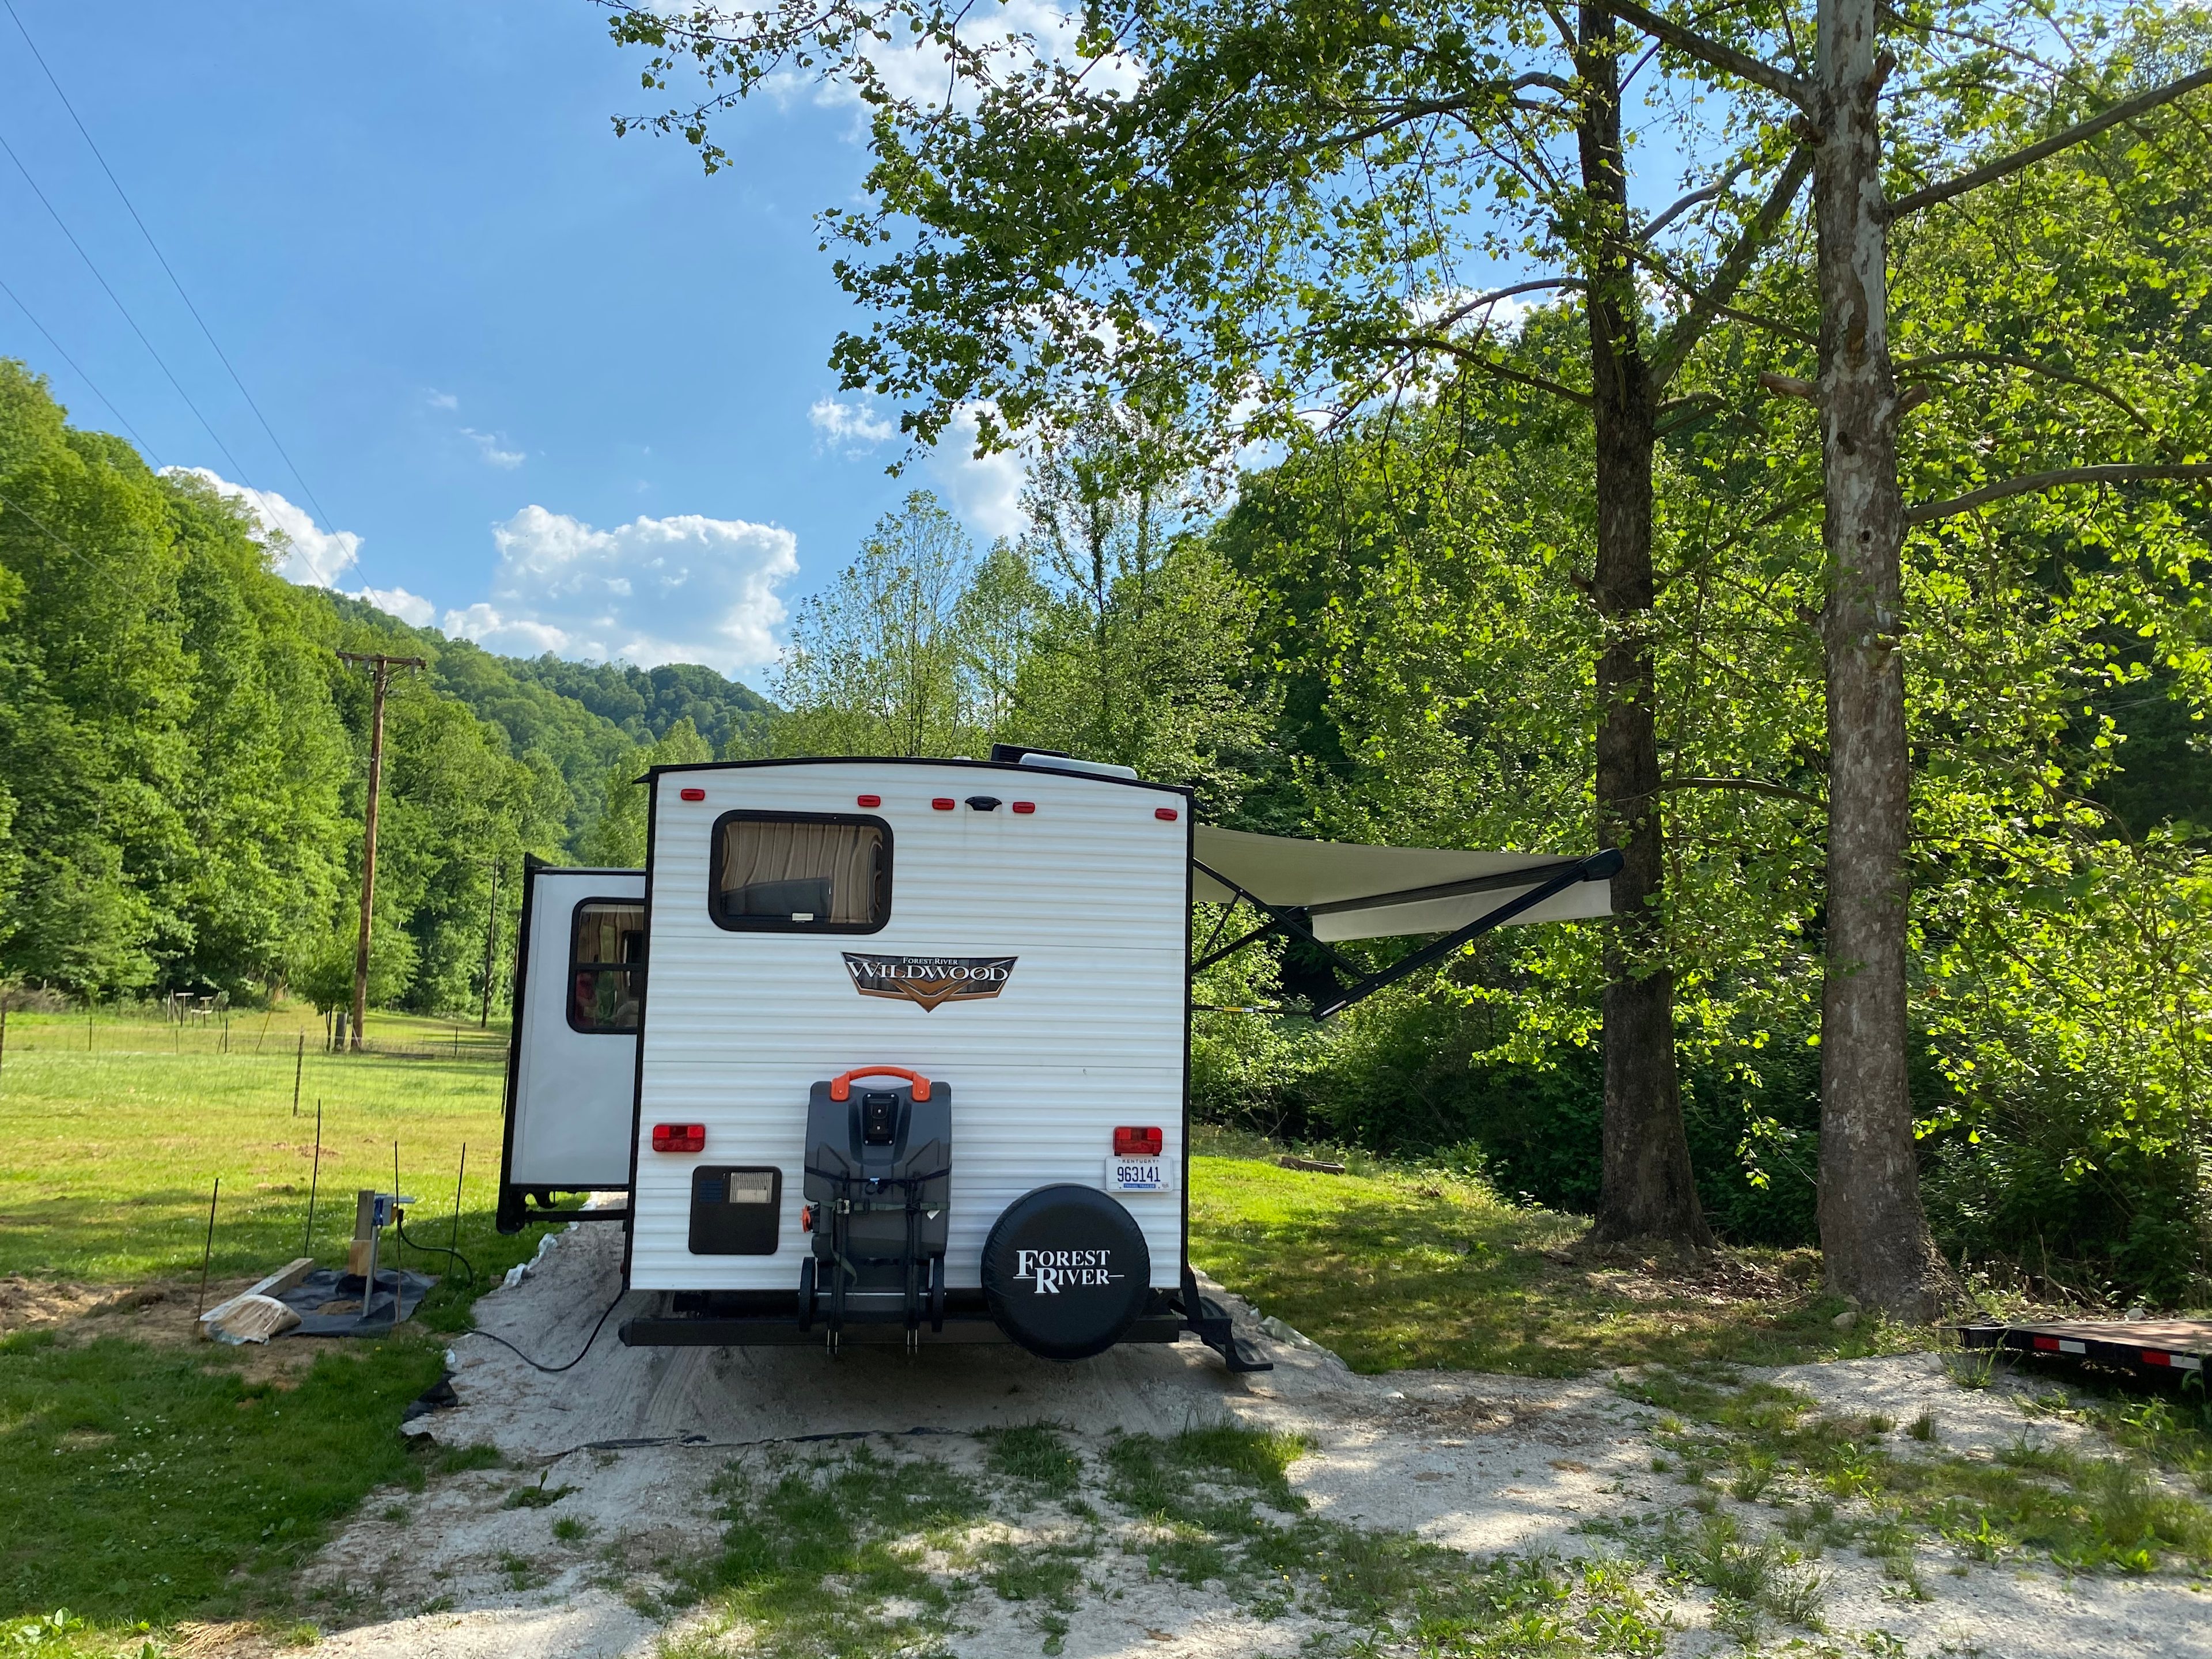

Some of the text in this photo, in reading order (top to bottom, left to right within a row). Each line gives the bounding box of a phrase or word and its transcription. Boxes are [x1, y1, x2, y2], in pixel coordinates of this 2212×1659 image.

[846, 961, 1008, 980] WILDWOOD
[903, 957, 933, 965] FOREST
[1118, 1166, 1161, 1182] 963141
[1016, 1250, 1110, 1277] FOREST
[1034, 1267, 1110, 1294] RIVER
